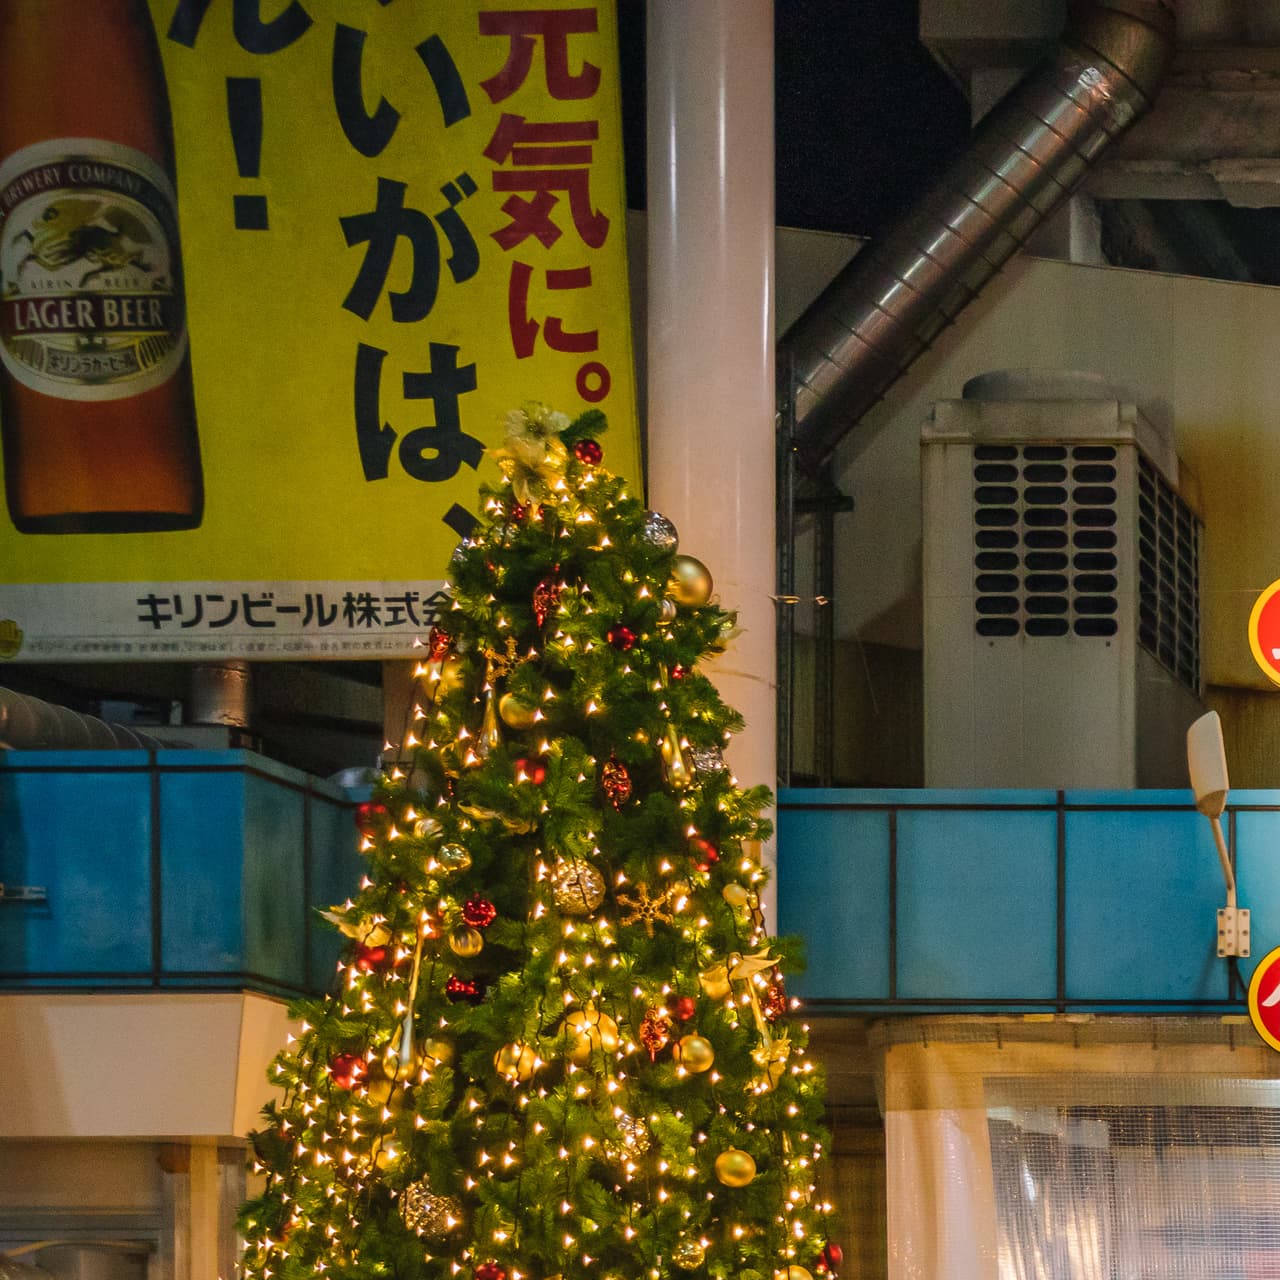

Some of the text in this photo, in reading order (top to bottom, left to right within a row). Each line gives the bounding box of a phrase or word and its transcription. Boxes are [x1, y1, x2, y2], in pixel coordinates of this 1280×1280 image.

[15, 299, 163, 331] LAGER BEER
[333, 0, 487, 540] いがは、
[479, 7, 611, 403] 元気に。
